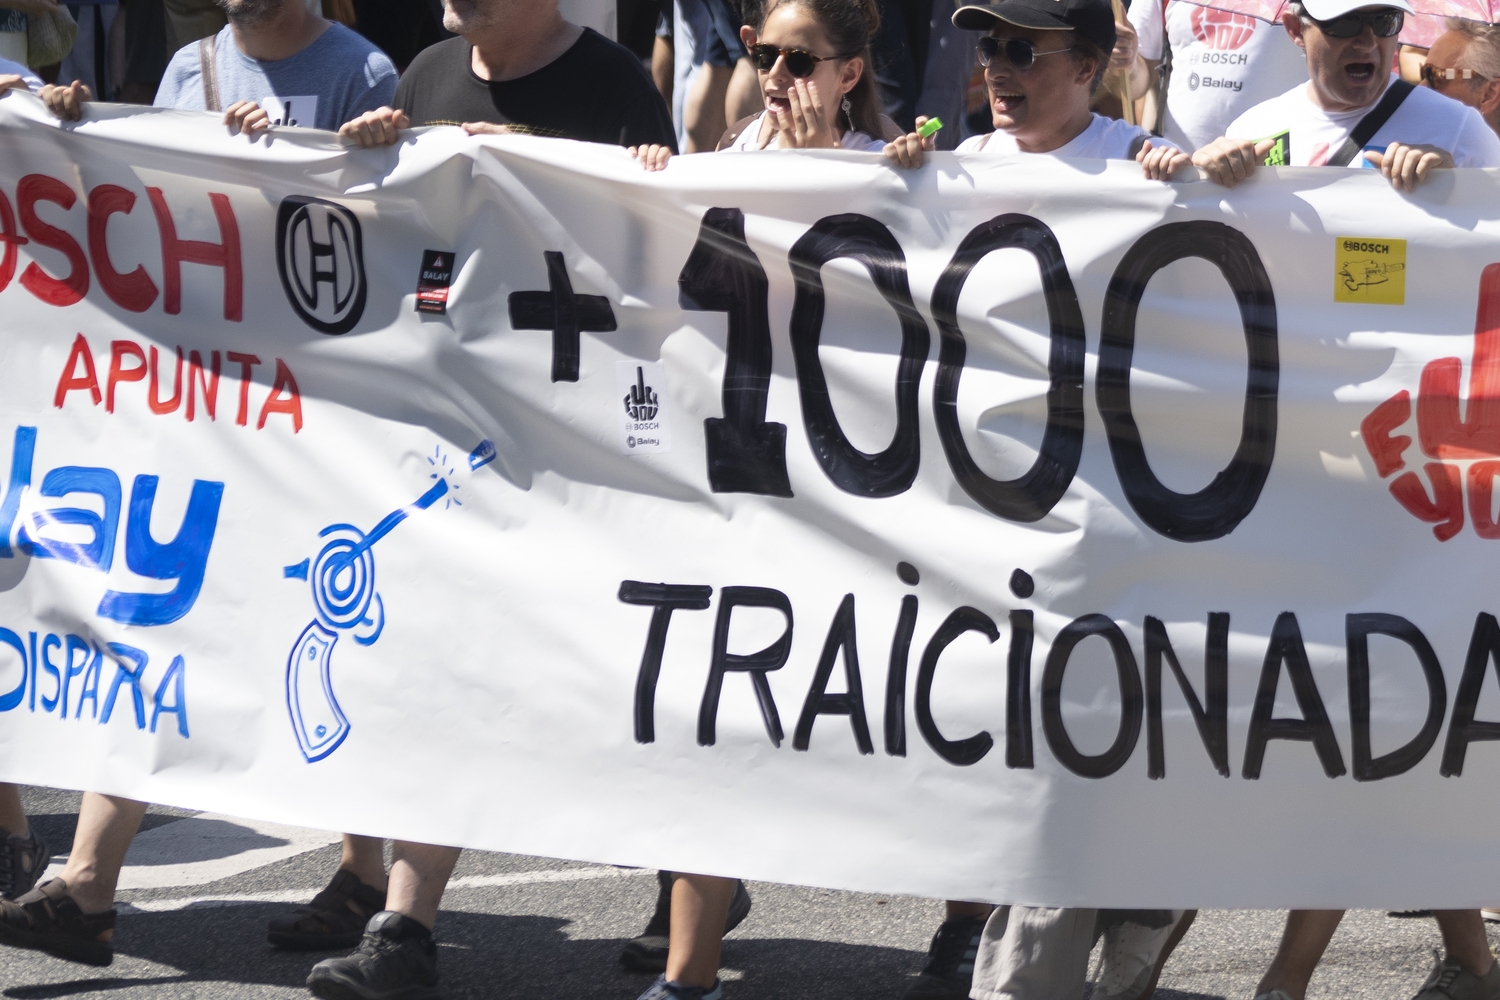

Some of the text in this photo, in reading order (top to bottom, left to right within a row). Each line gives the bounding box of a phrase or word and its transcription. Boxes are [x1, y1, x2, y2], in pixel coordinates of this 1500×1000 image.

[1202, 53, 1248, 65] BOSCH
[1202, 76, 1243, 92] Balay
[1353, 242, 1389, 254] BOSCH
[422, 270, 449, 281] BALAY
[53, 332, 303, 434] APUNTA
